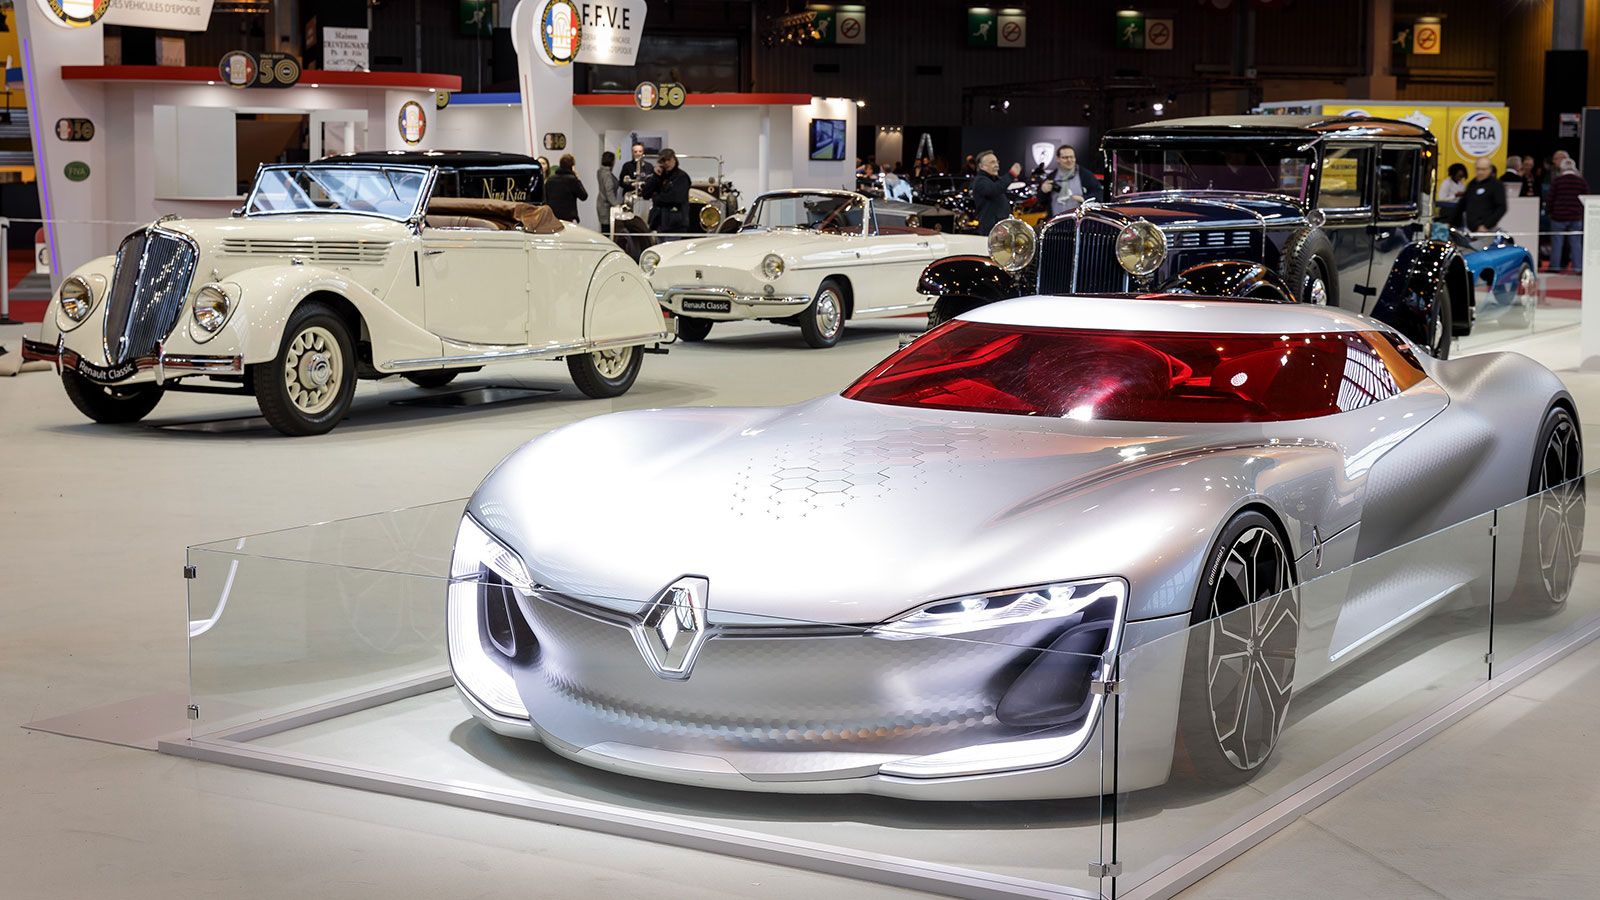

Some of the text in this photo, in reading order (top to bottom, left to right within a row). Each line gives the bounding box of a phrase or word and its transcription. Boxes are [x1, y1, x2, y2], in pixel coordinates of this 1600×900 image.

[582, 3, 630, 30] F.F.V.E
[659, 87, 685, 106] 50
[1462, 126, 1496, 140] FCRA
[482, 177, 527, 202] Nina Ricci
[684, 301, 729, 310] Renault Classic
[79, 360, 134, 380] Renault Classic
